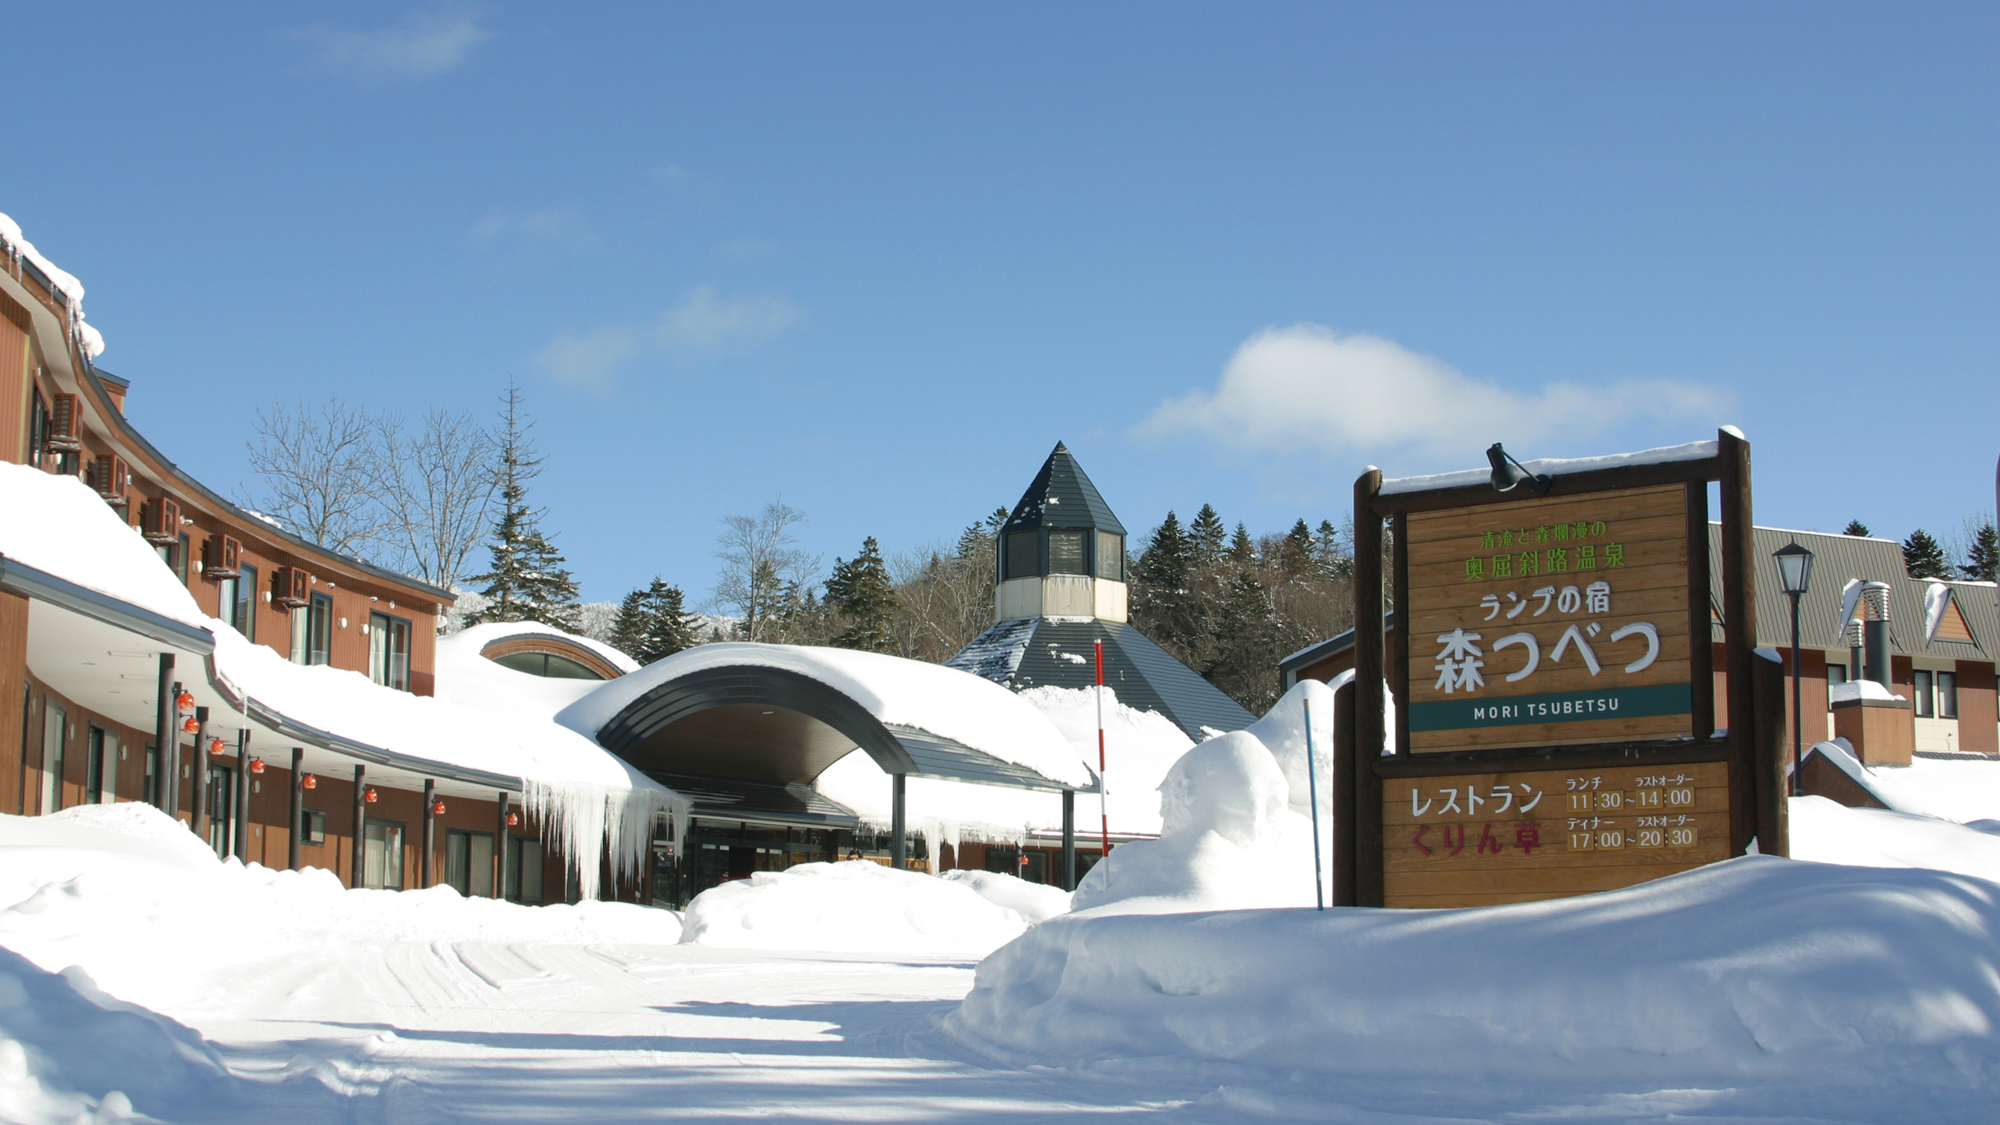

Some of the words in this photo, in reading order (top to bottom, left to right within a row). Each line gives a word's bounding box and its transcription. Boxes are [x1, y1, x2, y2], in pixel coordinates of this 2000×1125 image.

[1465, 542, 1626, 581] 奥屈斜路温泉
[1480, 581, 1611, 621] ランプの宿
[1434, 621, 1661, 693] 森つべつ
[1474, 705, 1518, 720] MORI
[1527, 698, 1619, 717] TSUBETSU
[1566, 776, 1602, 790] ランチ
[1636, 774, 1694, 787] ラストオーダー
[1412, 783, 1542, 817] レストラン
[1413, 821, 1542, 857] くりん草
[1567, 816, 1615, 830] ディナー
[1637, 814, 1695, 827] ラストオーダー
